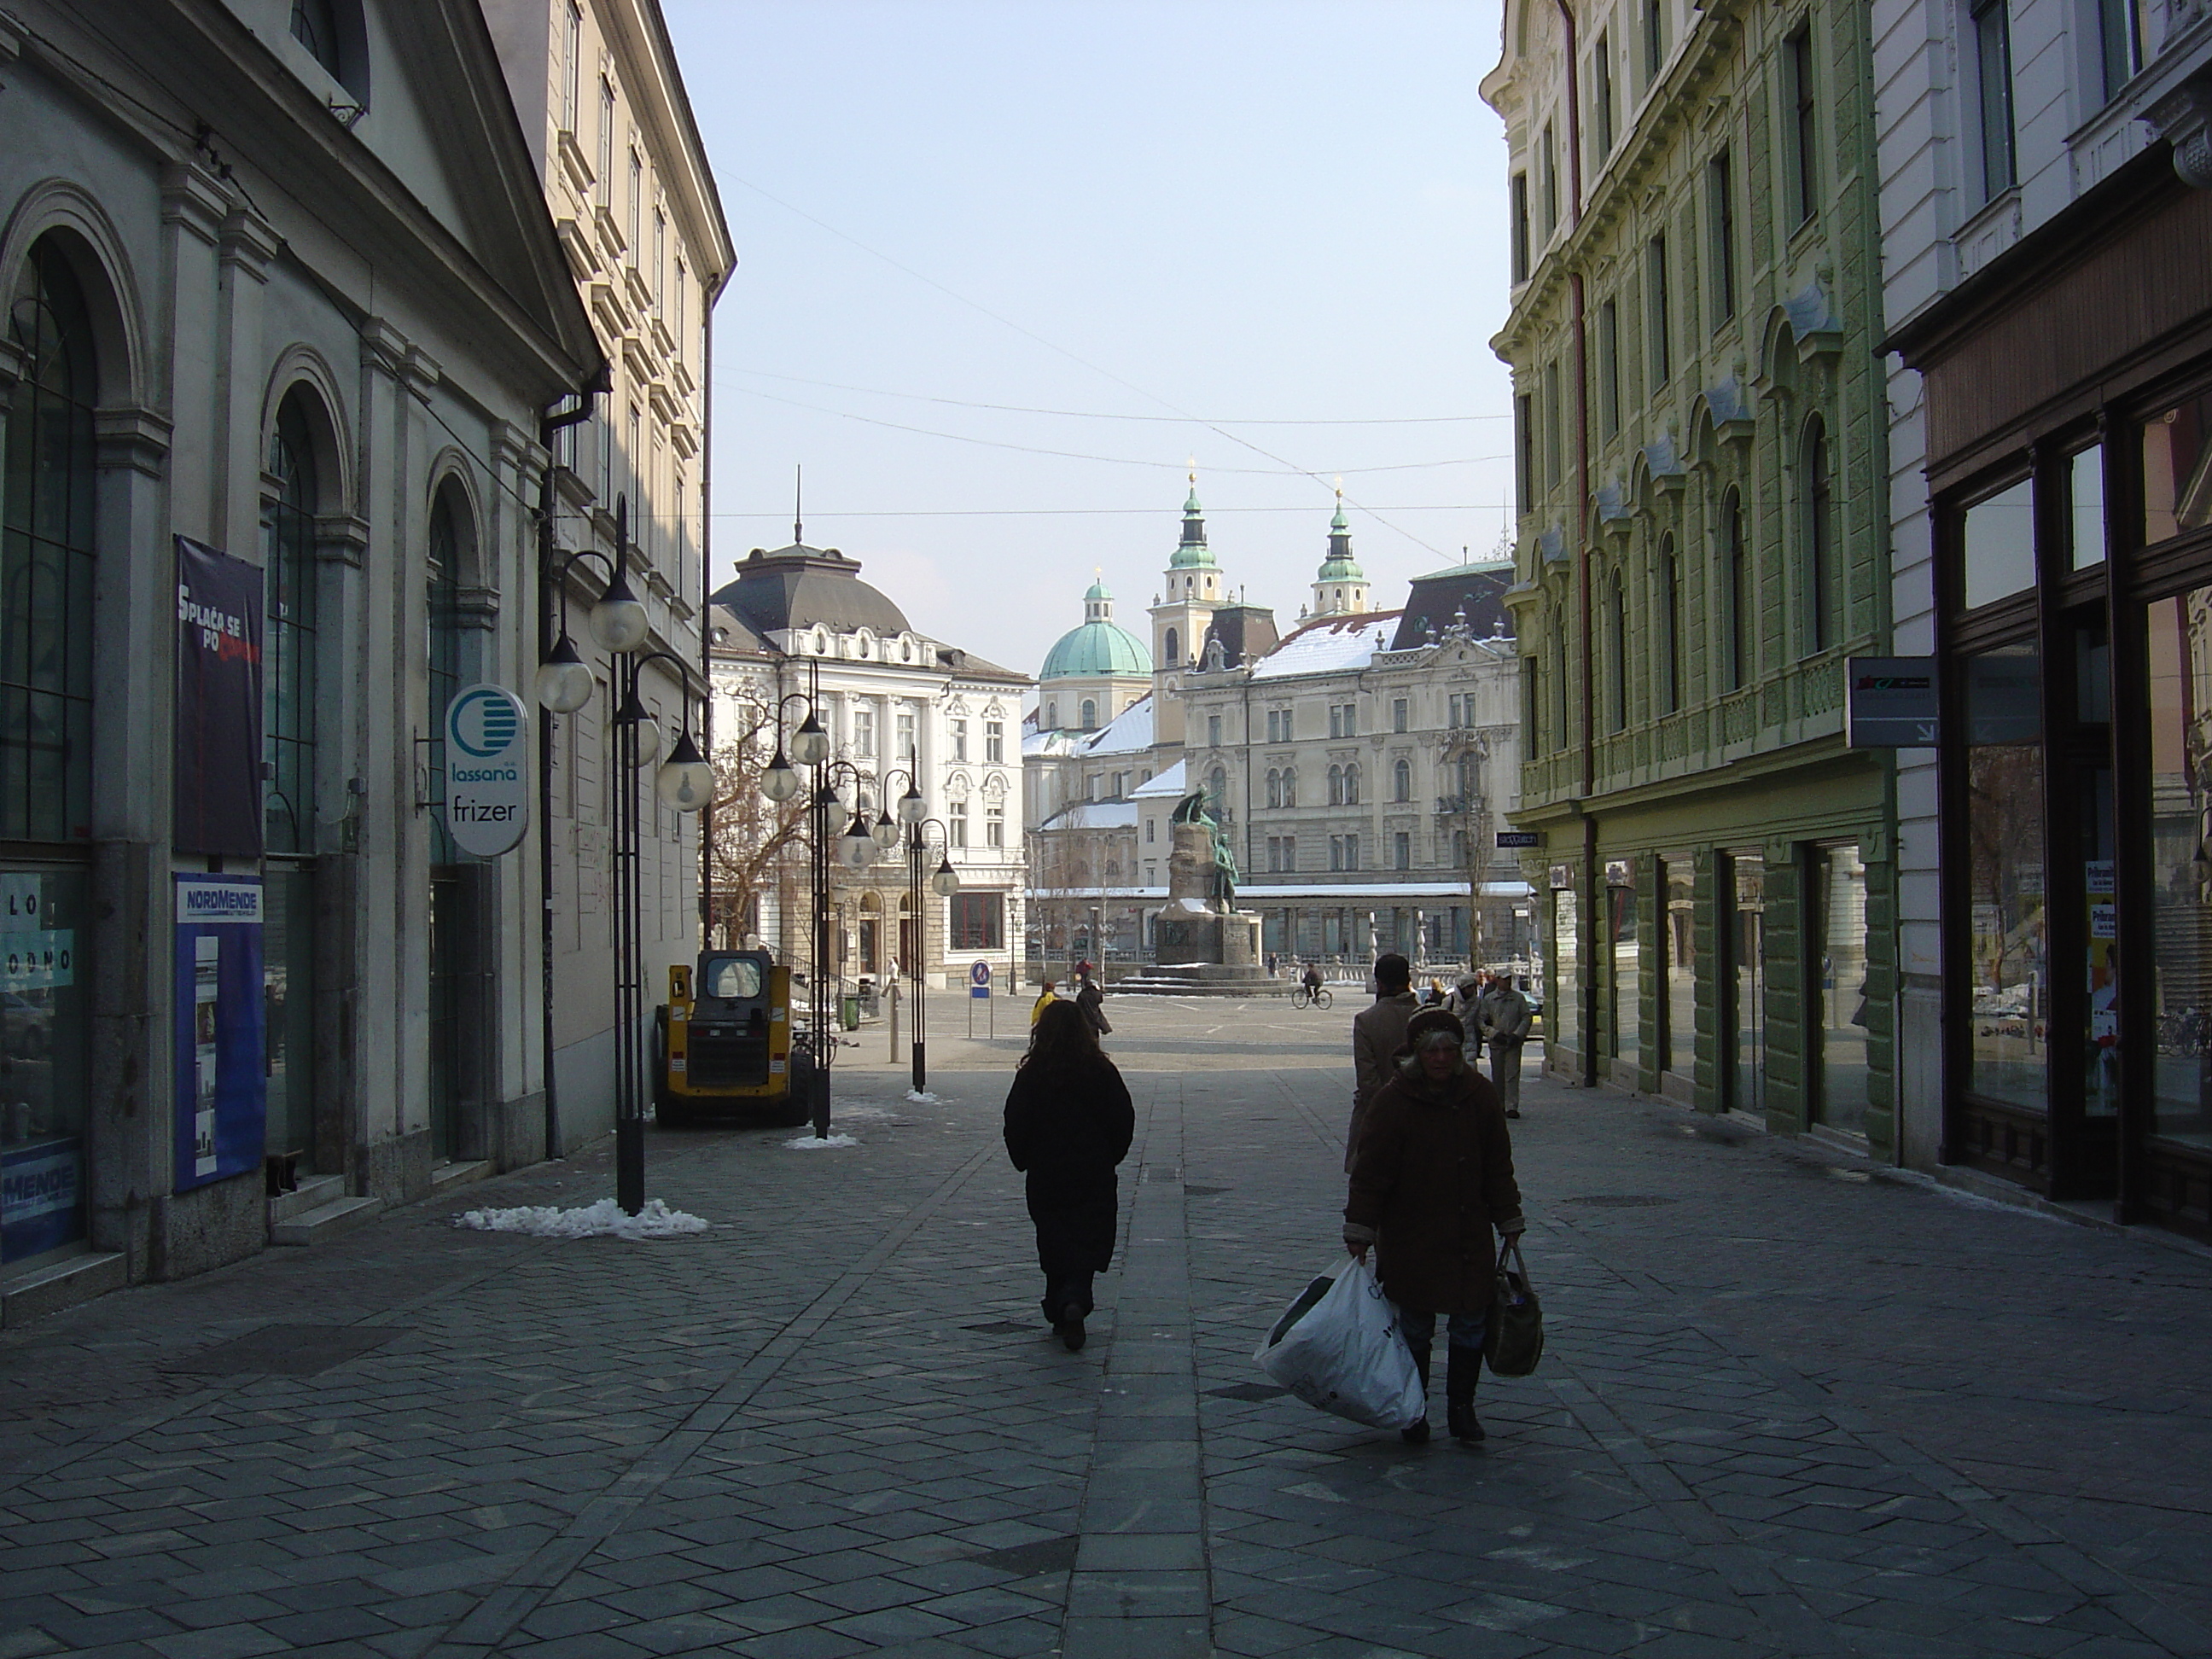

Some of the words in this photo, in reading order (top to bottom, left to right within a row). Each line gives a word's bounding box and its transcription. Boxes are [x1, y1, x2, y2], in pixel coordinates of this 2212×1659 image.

[227, 614, 241, 637] SE
[452, 762, 517, 782] lassana
[453, 795, 516, 822] frizer
